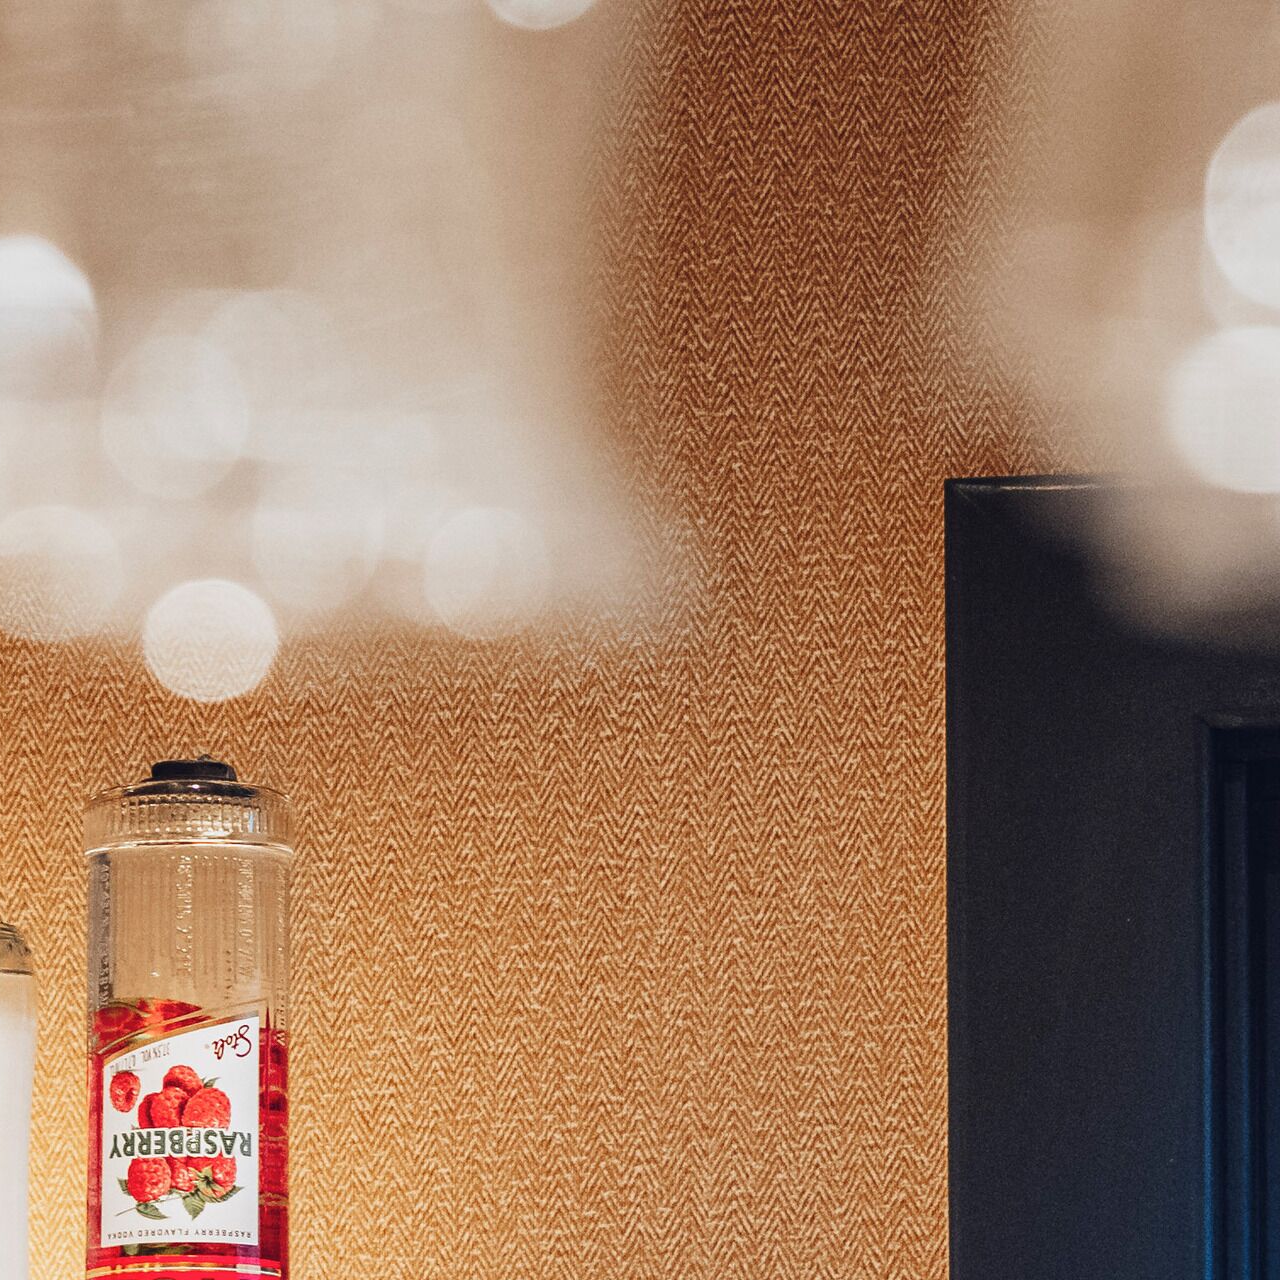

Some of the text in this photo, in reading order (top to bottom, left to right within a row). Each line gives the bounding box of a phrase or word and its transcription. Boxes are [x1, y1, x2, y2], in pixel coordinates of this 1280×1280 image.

[211, 1024, 252, 1060] Stoli
[109, 1129, 252, 1159] RASPBERRY
[107, 1228, 251, 1239] RASPBERRY FLAVORED VODKA
